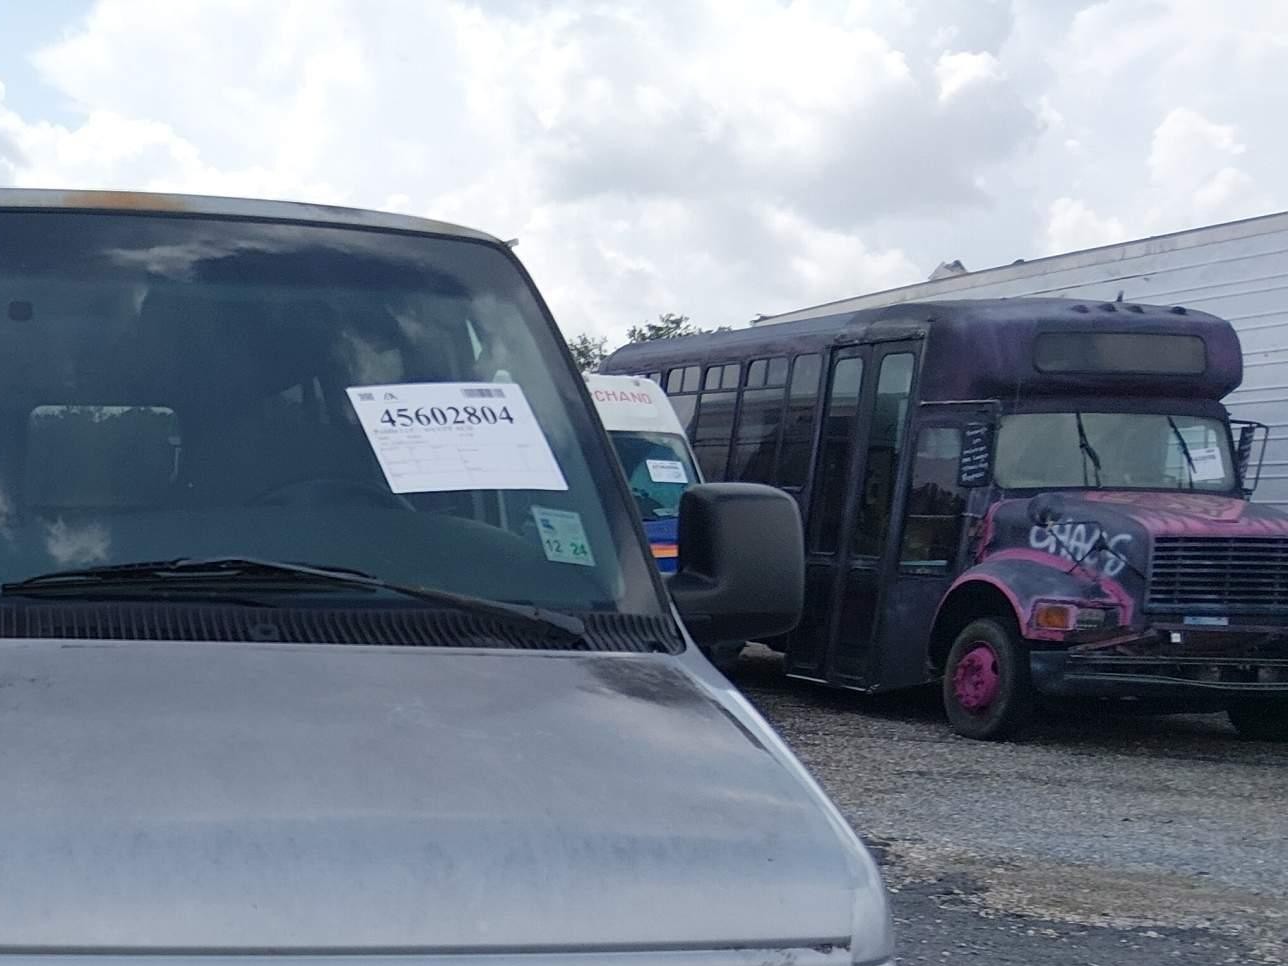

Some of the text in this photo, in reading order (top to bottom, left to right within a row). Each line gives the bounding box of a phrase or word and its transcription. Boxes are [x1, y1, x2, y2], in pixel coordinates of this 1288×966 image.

[380, 405, 514, 428] 45602804
[545, 539, 588, 556] 12 24
